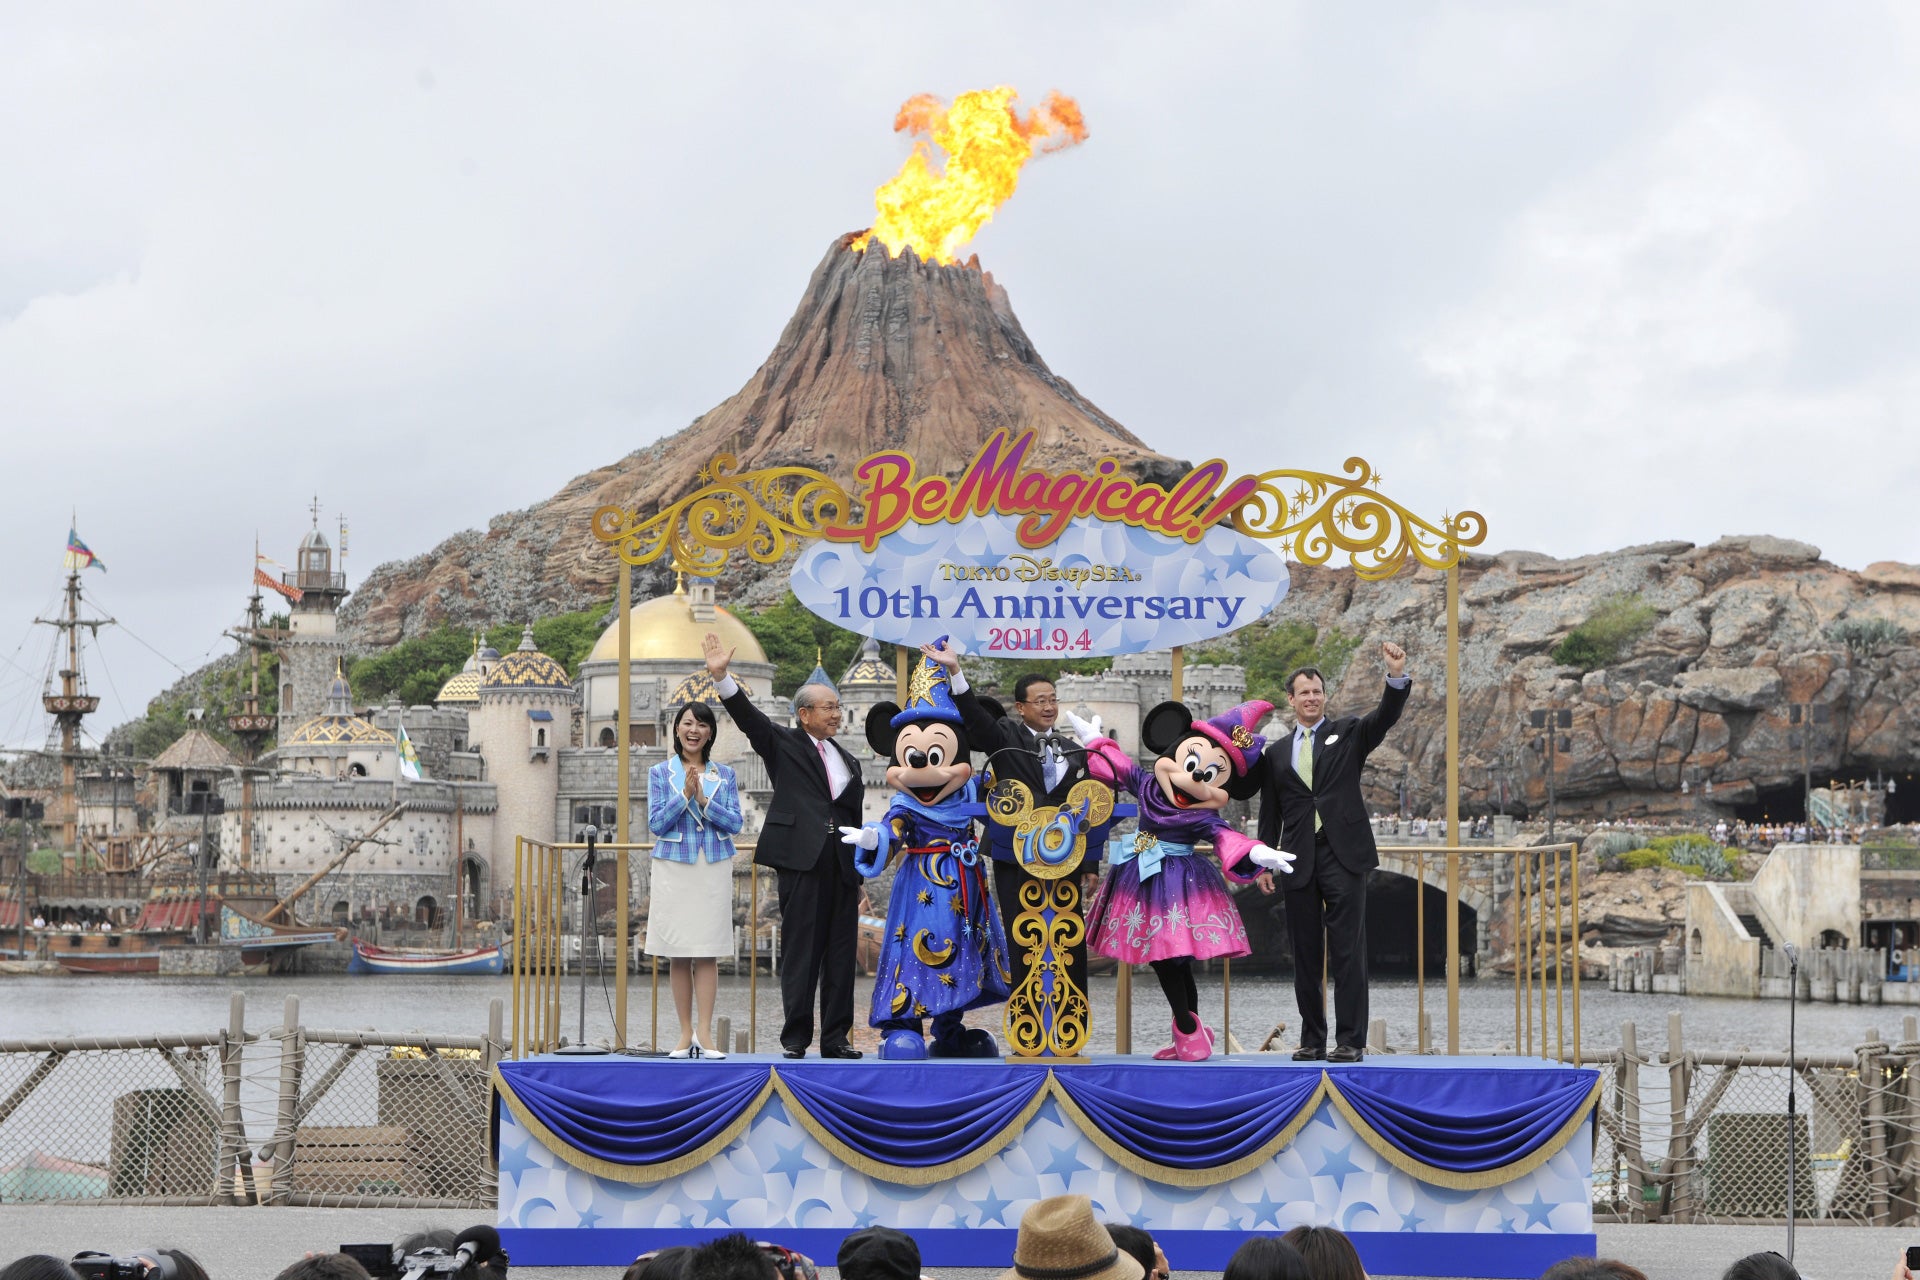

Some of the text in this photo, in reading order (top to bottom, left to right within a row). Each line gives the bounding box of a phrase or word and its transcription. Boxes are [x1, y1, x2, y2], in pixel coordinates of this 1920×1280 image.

[824, 429, 1259, 549] Be Magical!
[939, 563, 1011, 581] TOKYO
[833, 585, 1247, 628] 10th Anniversary
[988, 627, 1092, 651] 2011.9.4
[1017, 821, 1076, 865] 10
